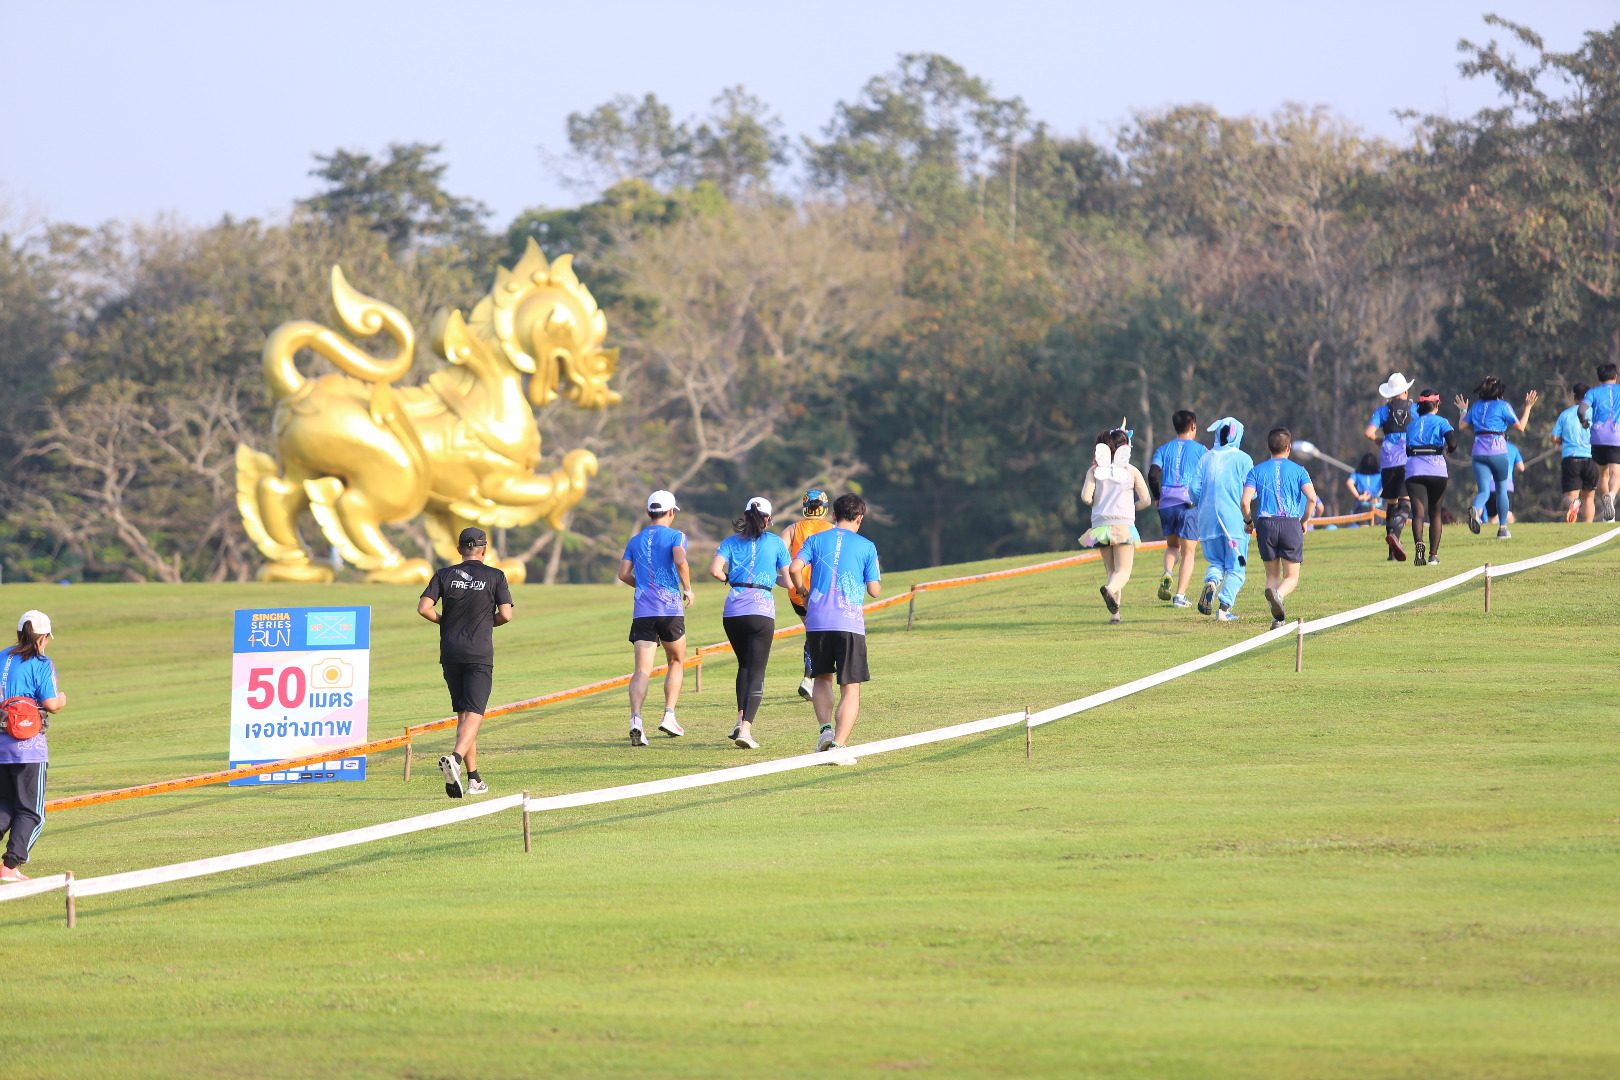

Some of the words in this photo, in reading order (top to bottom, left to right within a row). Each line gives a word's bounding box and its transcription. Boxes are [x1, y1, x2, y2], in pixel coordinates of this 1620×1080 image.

[252, 613, 290, 621] SINGHA
[251, 621, 291, 630] SERIES
[310, 624, 323, 632] SP
[339, 623, 353, 631] XC
[247, 666, 306, 710] 50
[310, 692, 353, 708] เมตร
[245, 715, 353, 739] เจอช่างภาพ
